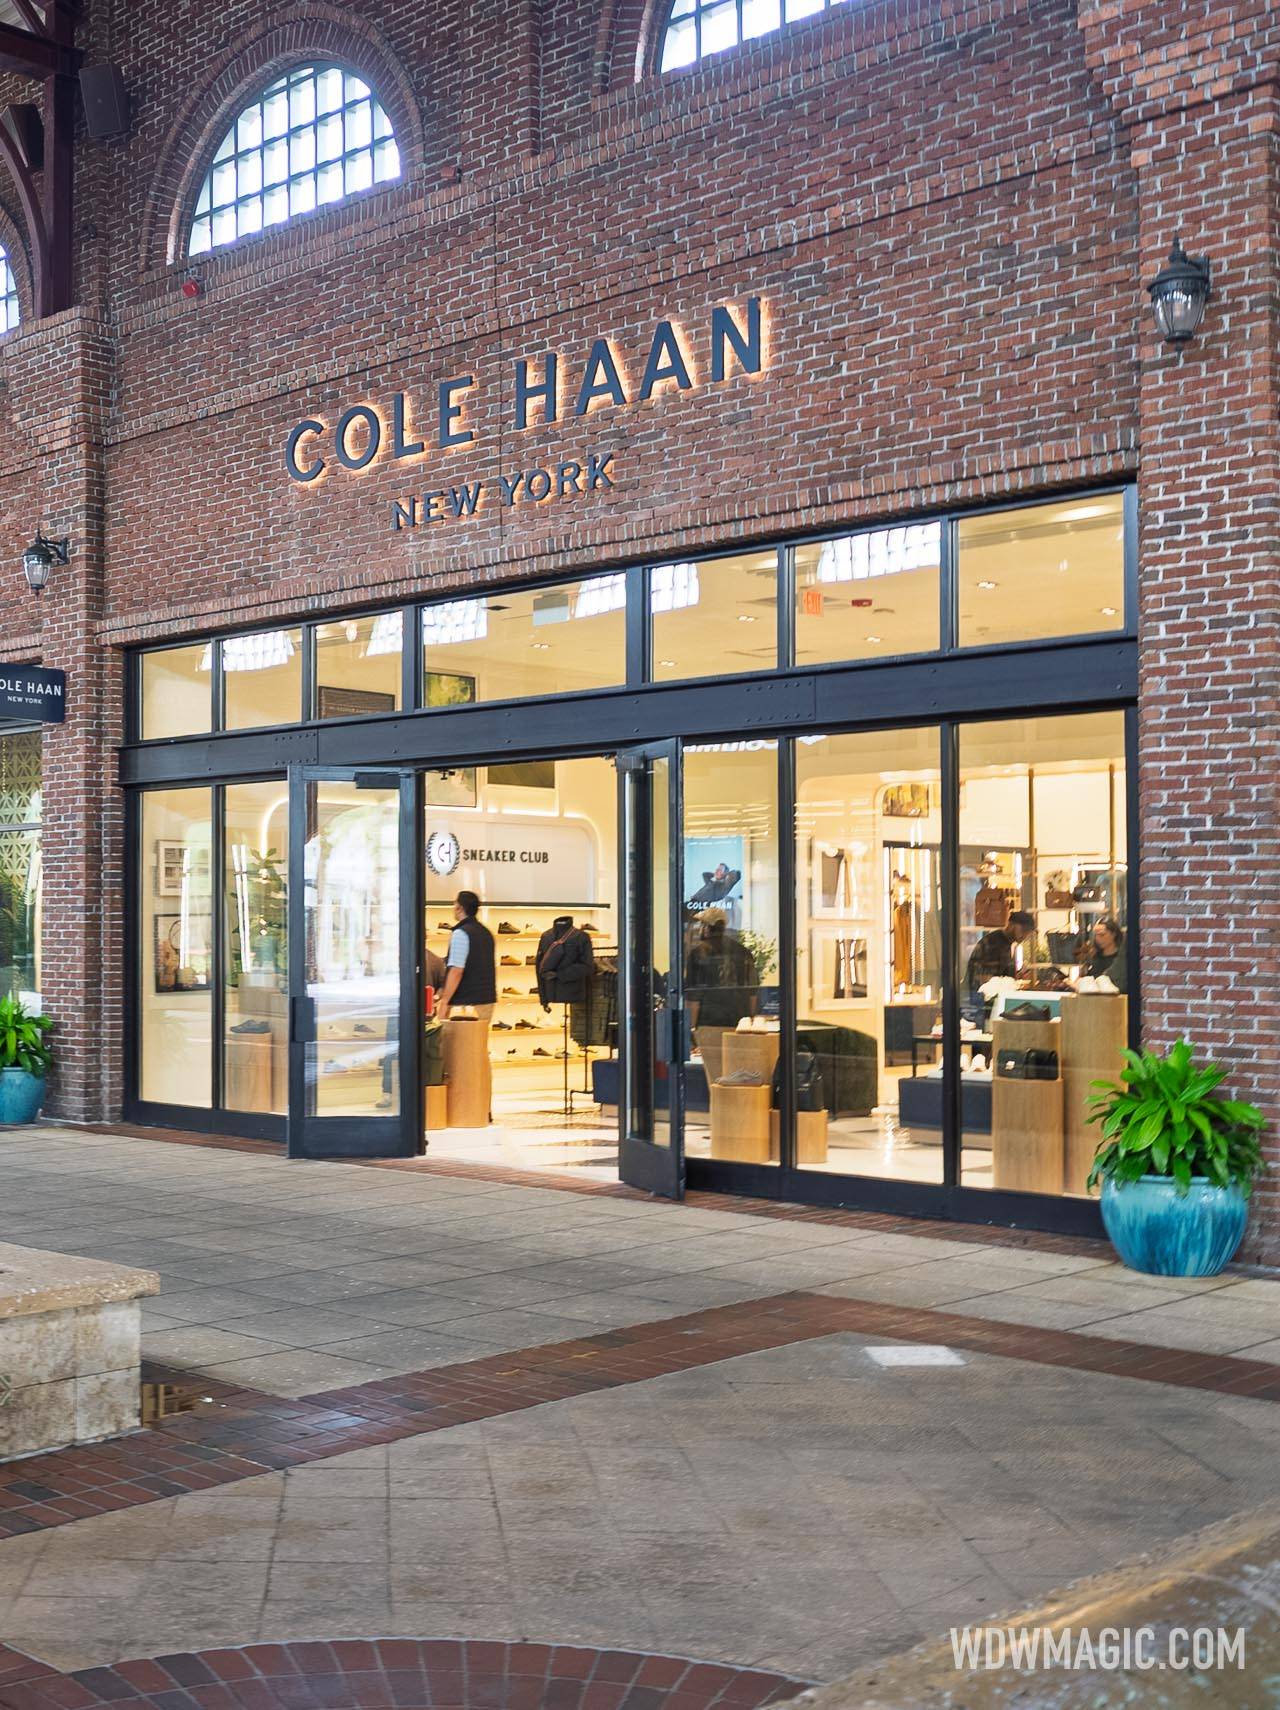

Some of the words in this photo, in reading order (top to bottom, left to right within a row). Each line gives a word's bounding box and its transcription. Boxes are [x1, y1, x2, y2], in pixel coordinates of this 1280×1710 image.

[285, 375, 474, 483] COLE
[514, 296, 762, 431] HAAN
[391, 481, 482, 531] NEW
[497, 453, 615, 507] YORK
[26, 681, 62, 697] HAAN
[7, 695, 23, 703] NEW
[24, 697, 42, 705] YORK
[462, 848, 516, 863] SNEAKER
[519, 851, 550, 864] CLUB
[686, 900, 708, 910] COLE
